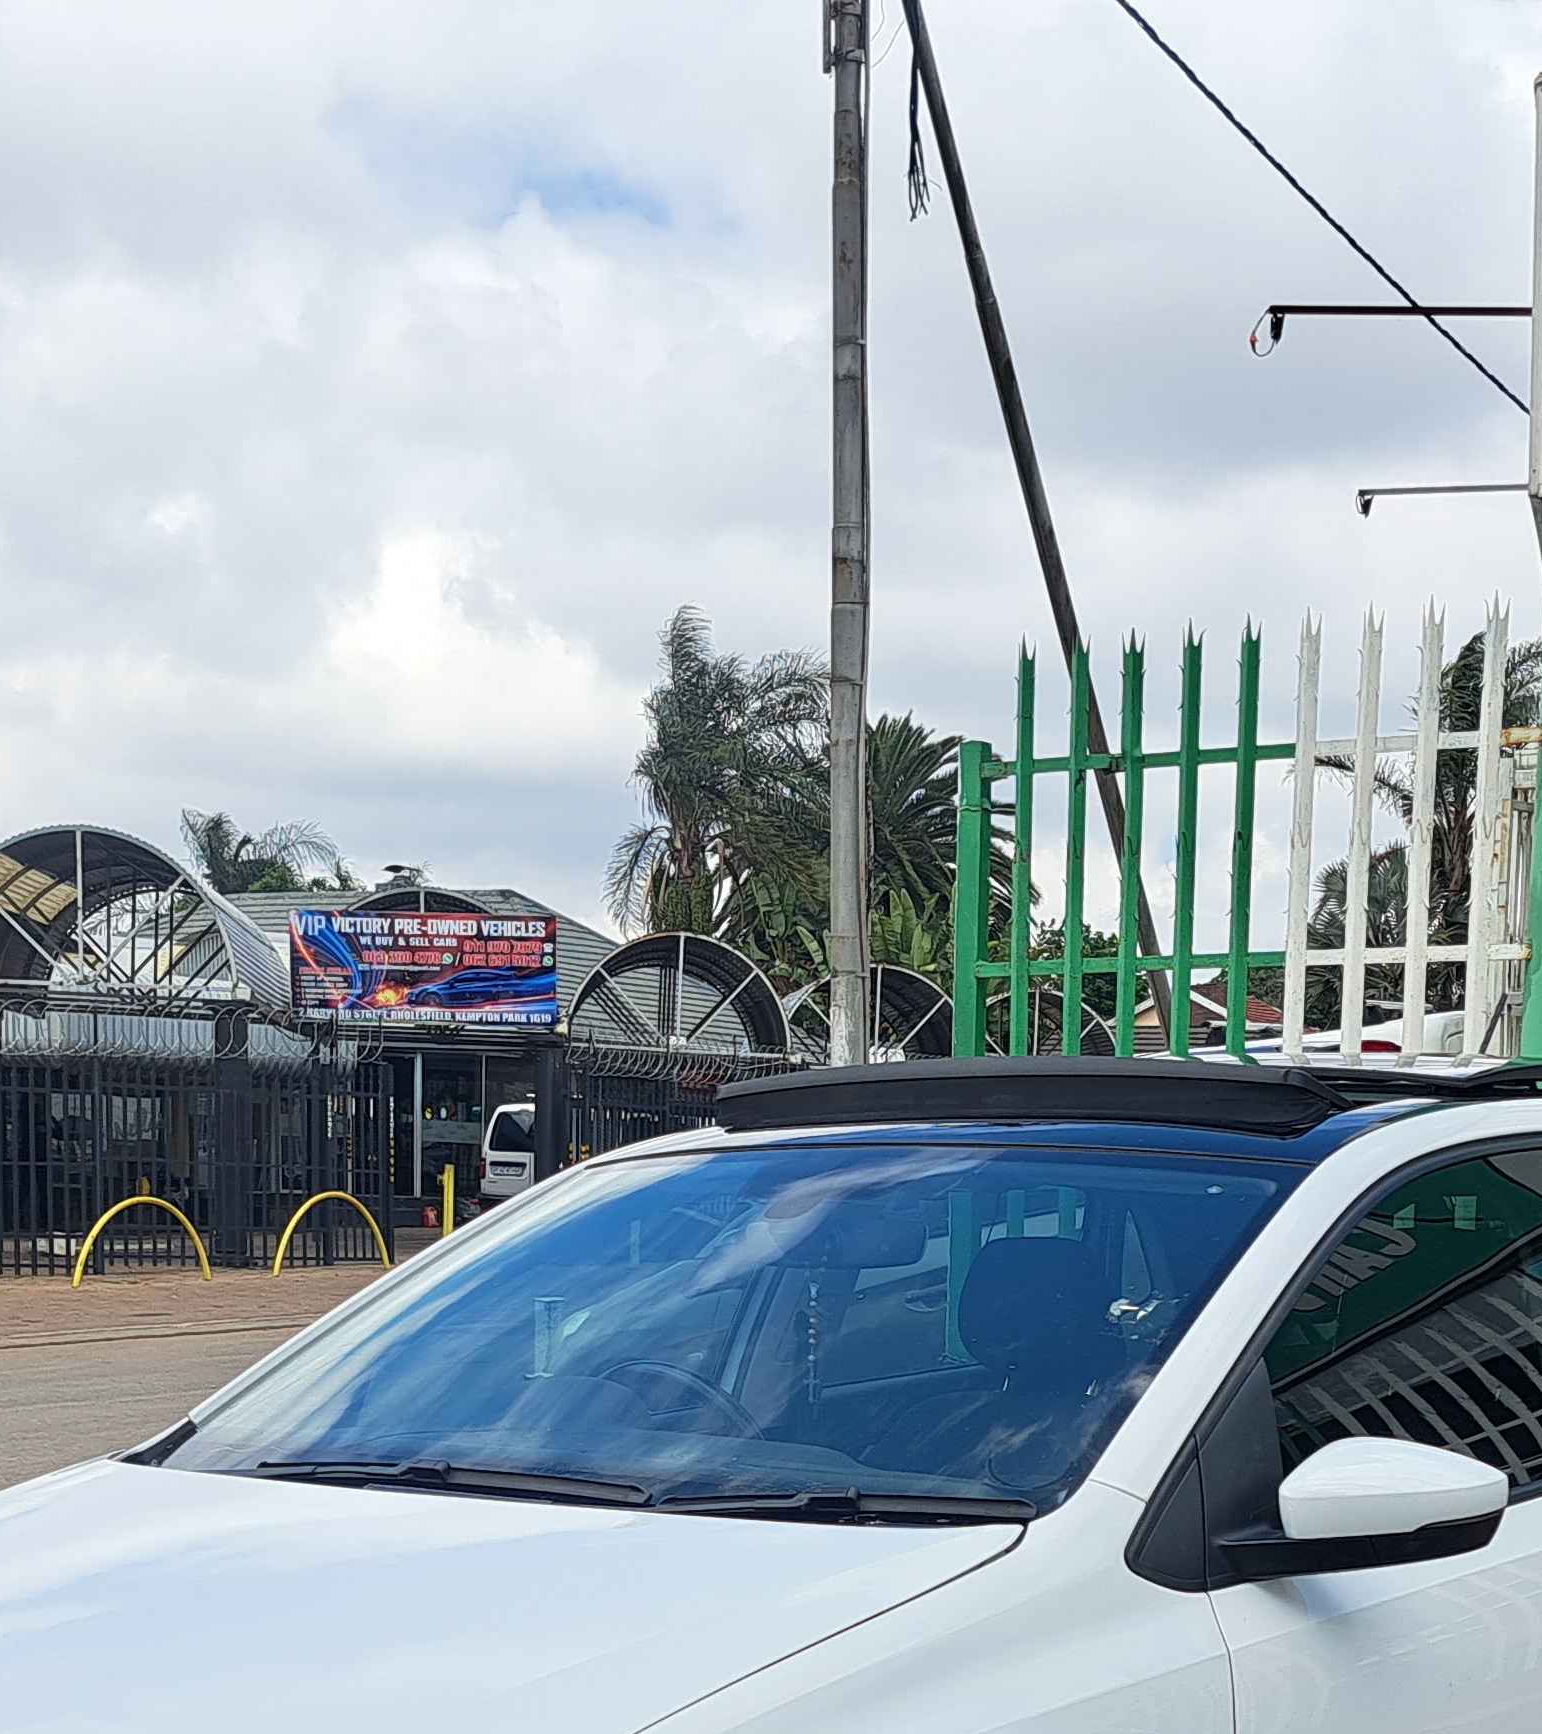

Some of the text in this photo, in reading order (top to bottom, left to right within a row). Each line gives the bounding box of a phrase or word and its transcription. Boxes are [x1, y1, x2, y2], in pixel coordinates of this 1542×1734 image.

[294, 915, 545, 938] VIP VICTORY PRE-OWNED VEHICLES
[360, 936, 371, 946] WE
[375, 936, 393, 946] BUY
[410, 937, 430, 947] SELL
[455, 1011, 500, 1022] KEMPTON
